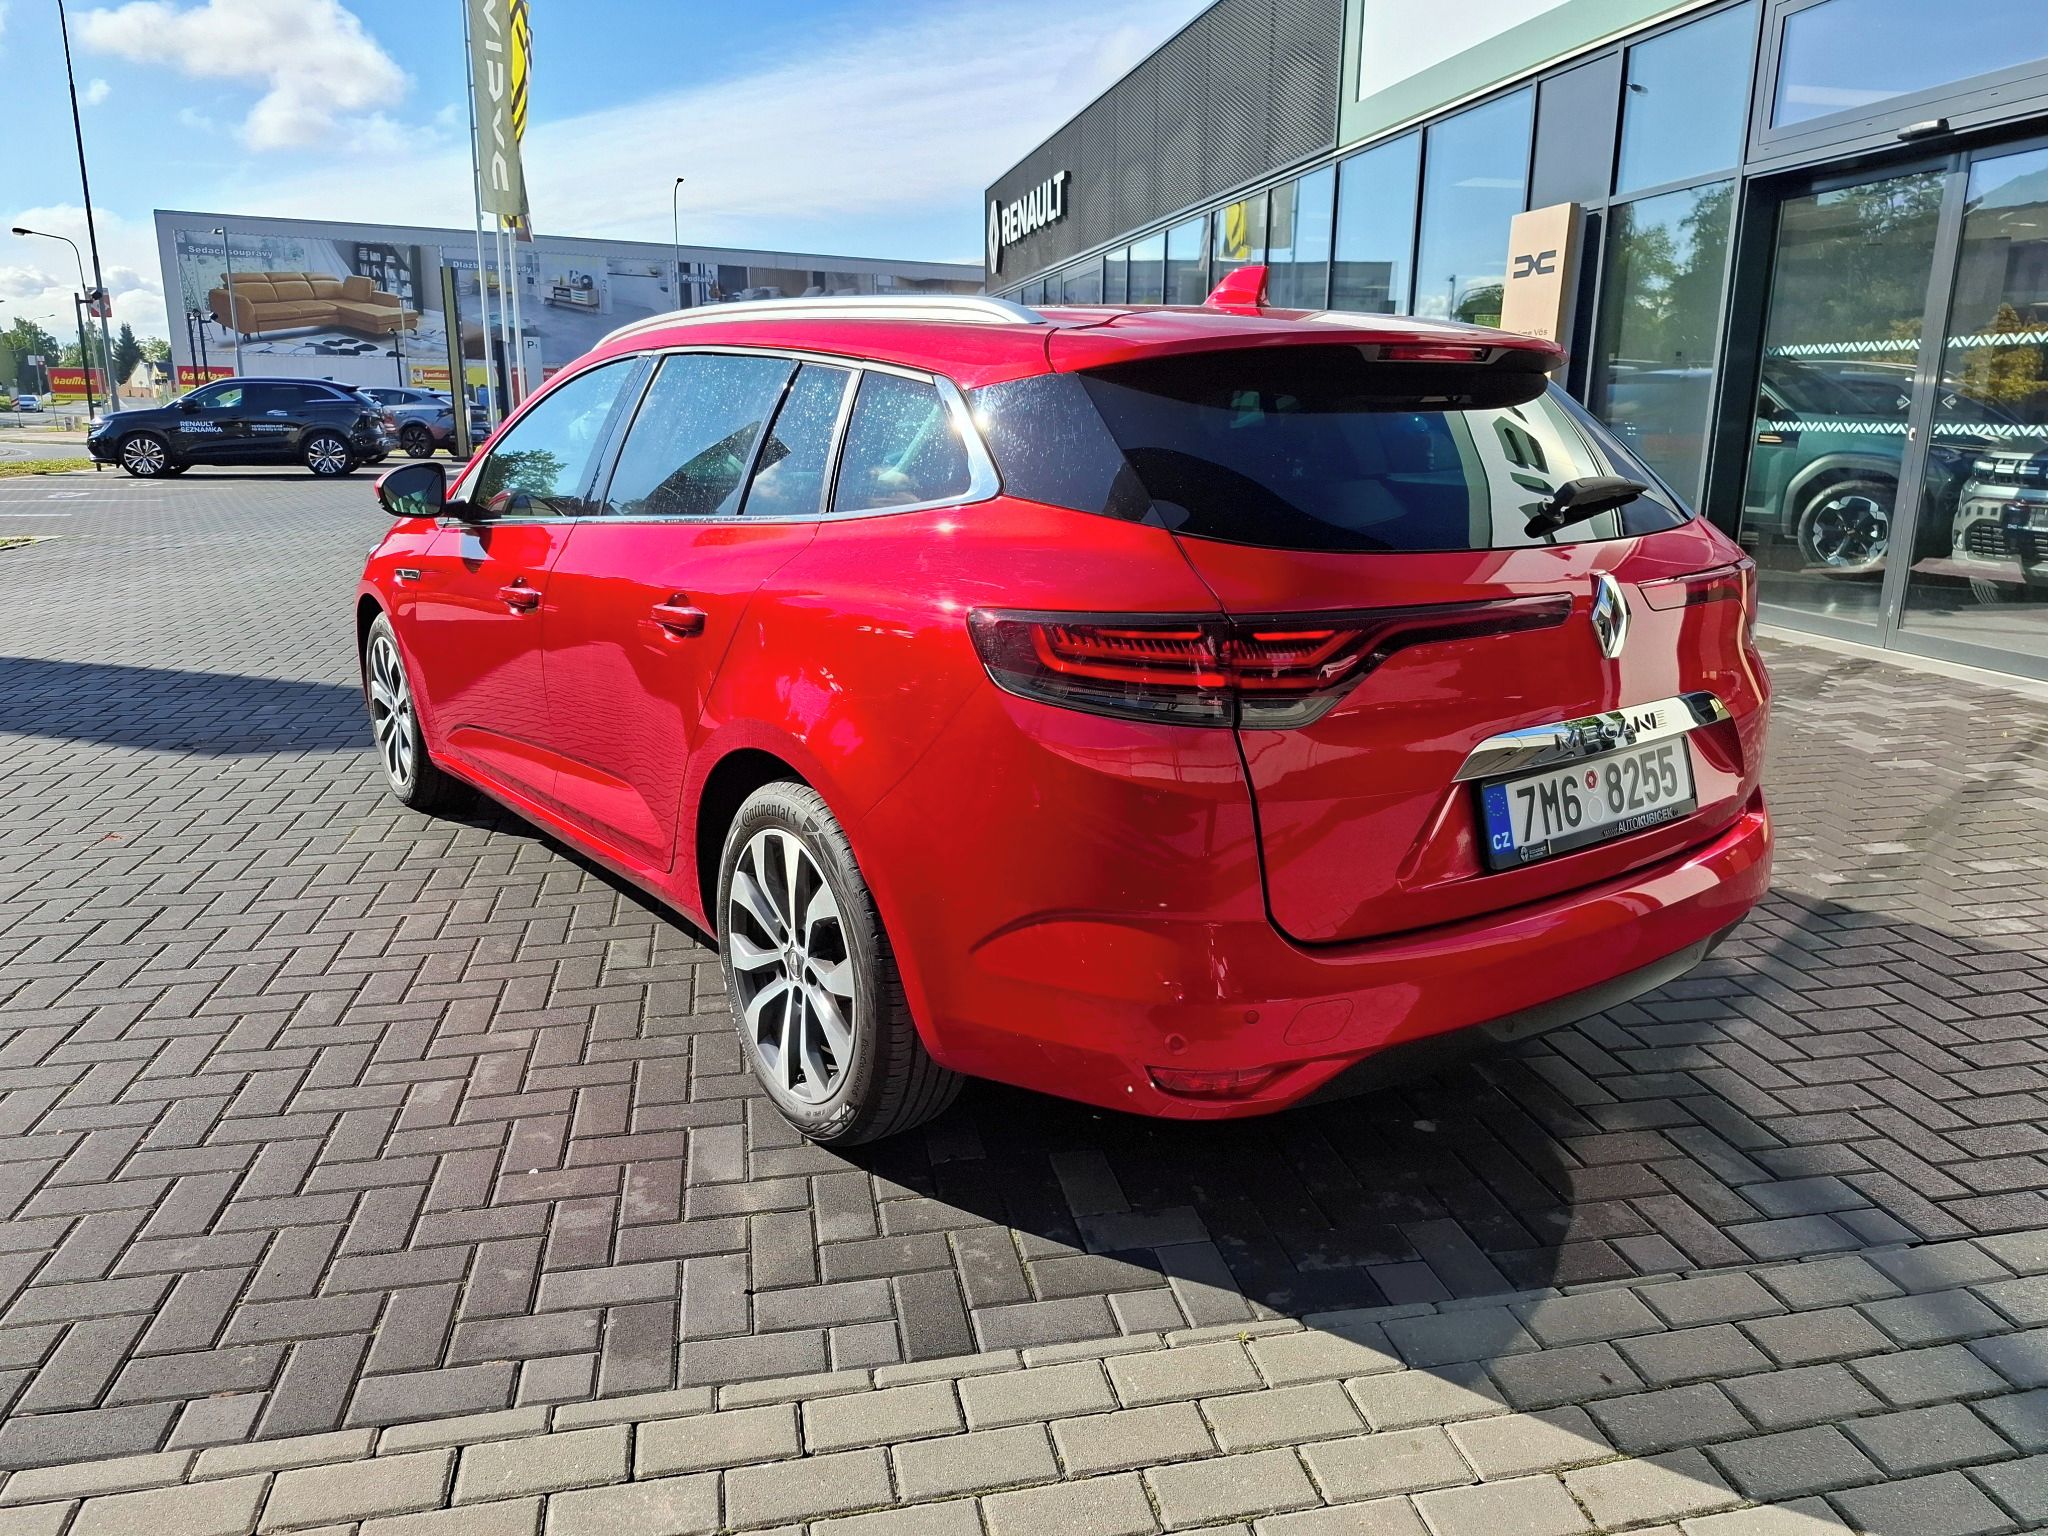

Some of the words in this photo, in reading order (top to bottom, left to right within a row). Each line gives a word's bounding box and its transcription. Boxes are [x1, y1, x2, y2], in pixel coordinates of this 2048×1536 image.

[1001, 170, 1065, 247] RENAULT
[227, 249, 273, 259] soupravy
[453, 260, 480, 269] Dlažb
[1516, 775, 1583, 843] 7M6
[1604, 745, 1679, 814] 8255
[742, 801, 791, 827] Continental
[1492, 831, 1511, 850] CZ
